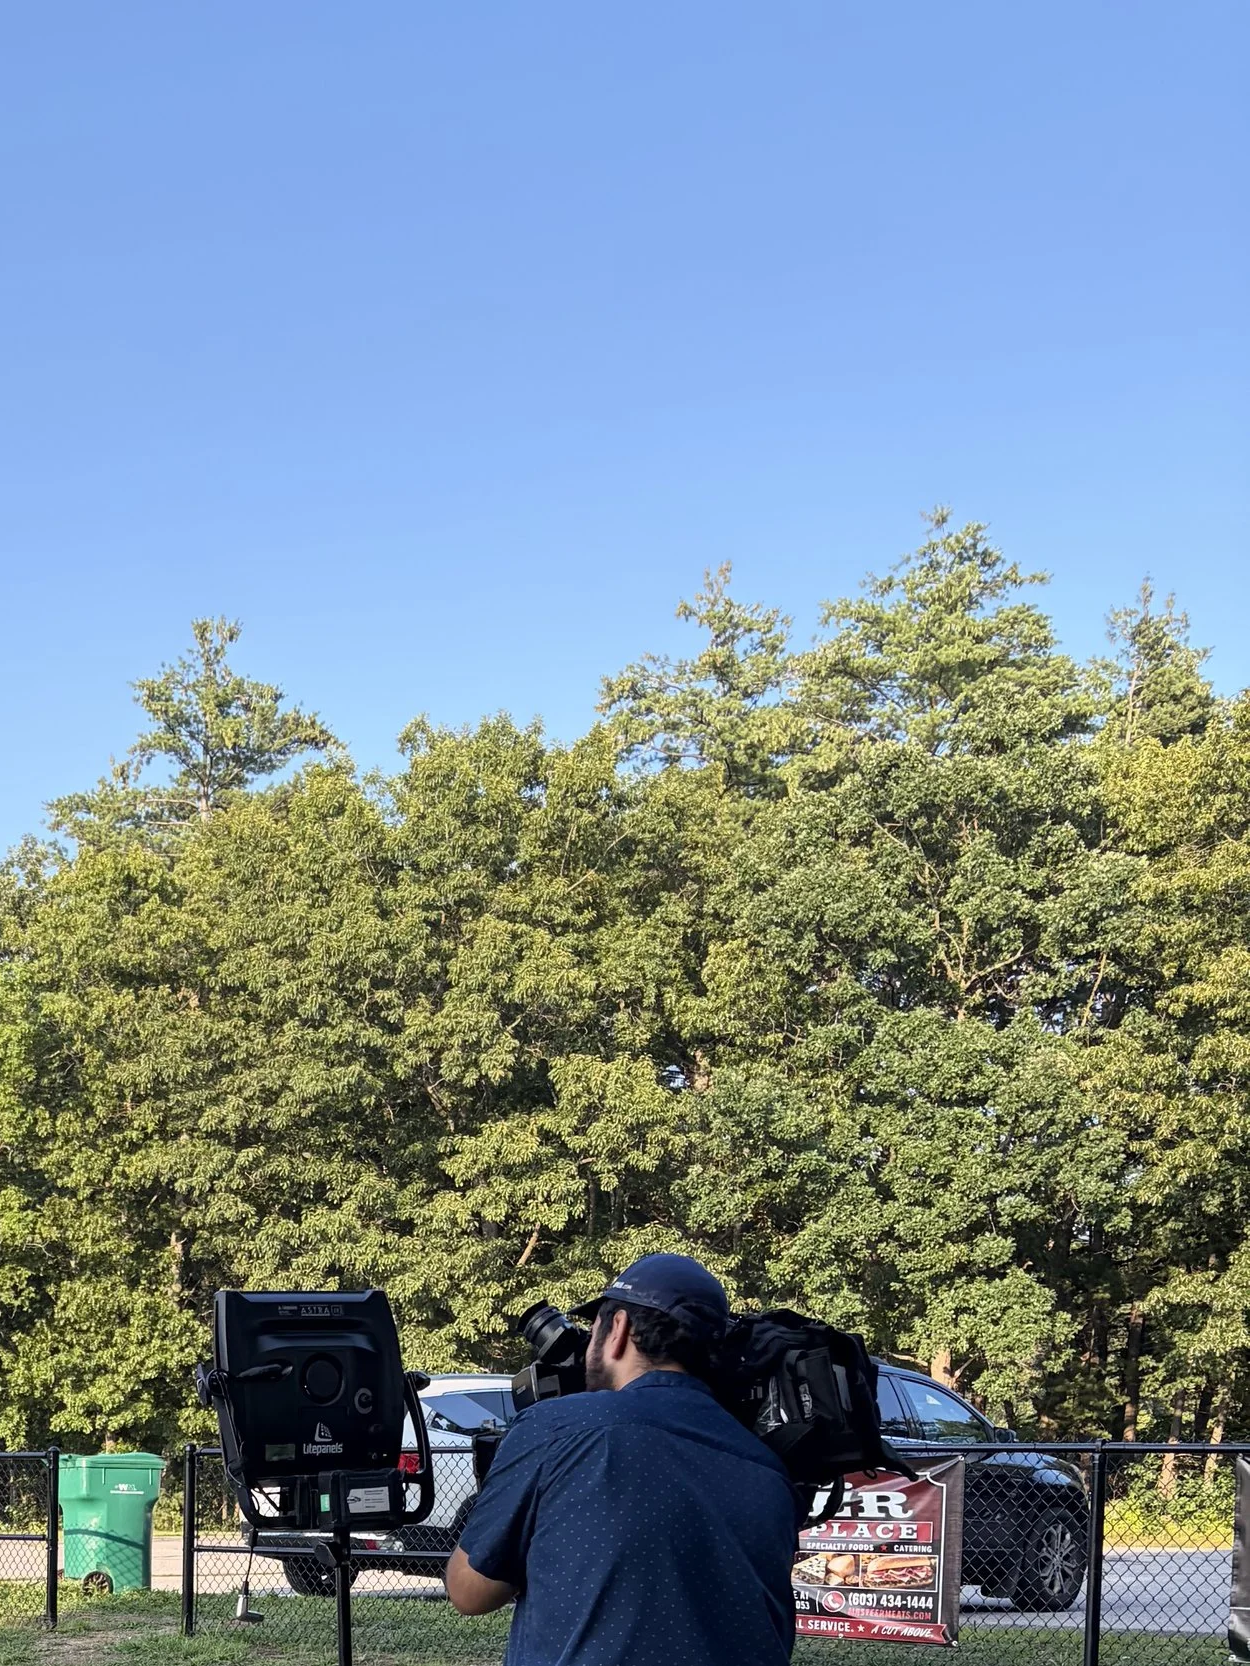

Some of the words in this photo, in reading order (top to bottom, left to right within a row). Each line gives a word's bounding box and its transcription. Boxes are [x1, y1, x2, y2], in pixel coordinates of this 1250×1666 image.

[303, 1443, 343, 1456] Litepanels
[809, 1523, 917, 1539] PLACE
[806, 1542, 846, 1551] SPECIALTY
[848, 1543, 874, 1551] FOODS
[893, 1544, 932, 1553] CATERING
[848, 1592, 877, 1607] (603)
[880, 1594, 933, 1609] 434-1444
[807, 1620, 854, 1632] SERVICE.
[871, 1625, 879, 1634] A
[881, 1625, 899, 1636] CUT
[900, 1627, 933, 1638] ABOVE.
